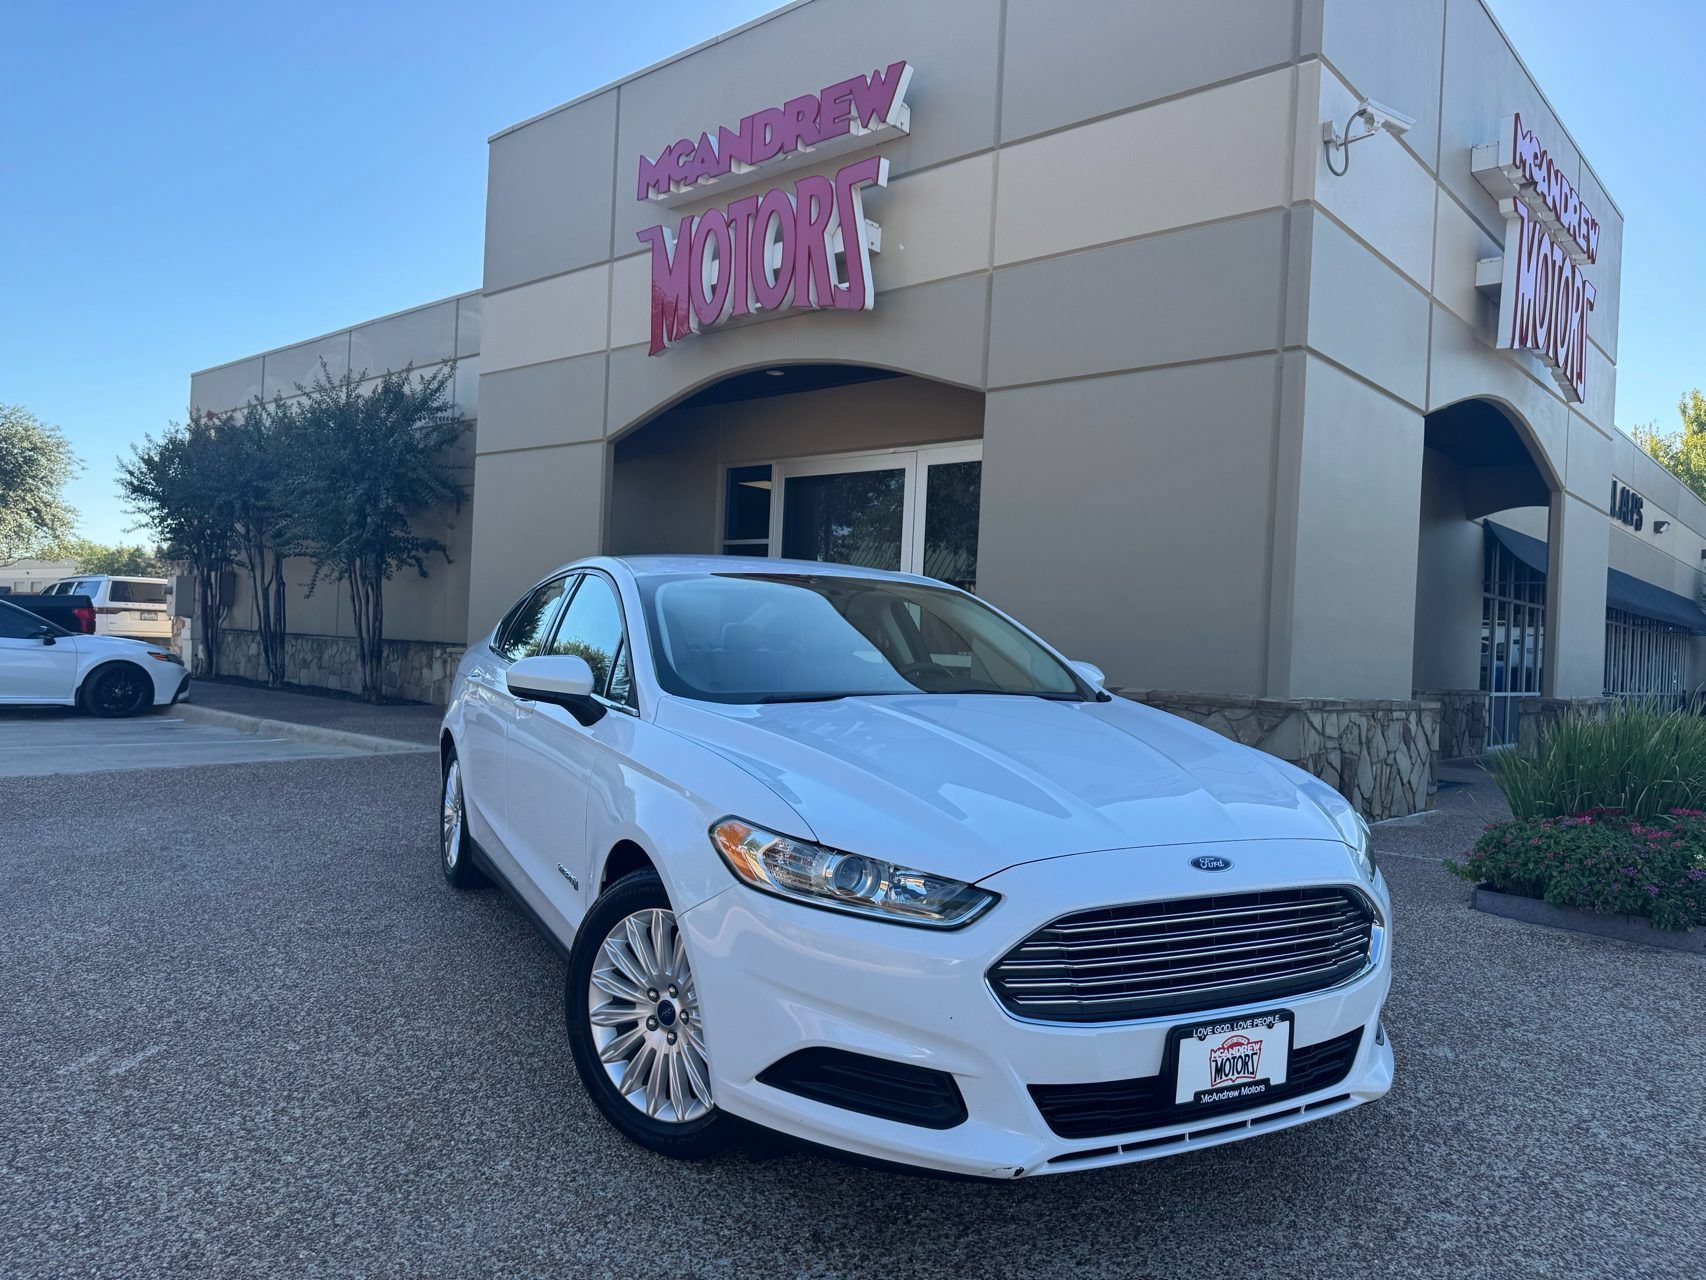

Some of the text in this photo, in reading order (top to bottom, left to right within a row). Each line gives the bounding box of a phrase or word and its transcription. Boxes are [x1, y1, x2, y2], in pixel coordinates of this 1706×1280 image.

[636, 155, 884, 356] MOTORS
[1510, 196, 1597, 403] MOTORS
[1200, 857, 1225, 869] Ford
[1193, 1026, 1213, 1037] LOVE
[1214, 1024, 1232, 1034] GOD.
[1234, 1019, 1252, 1030] LOVE
[1212, 1052, 1258, 1083] MOTORS
[1200, 1084, 1265, 1104] McAndrew Motors
